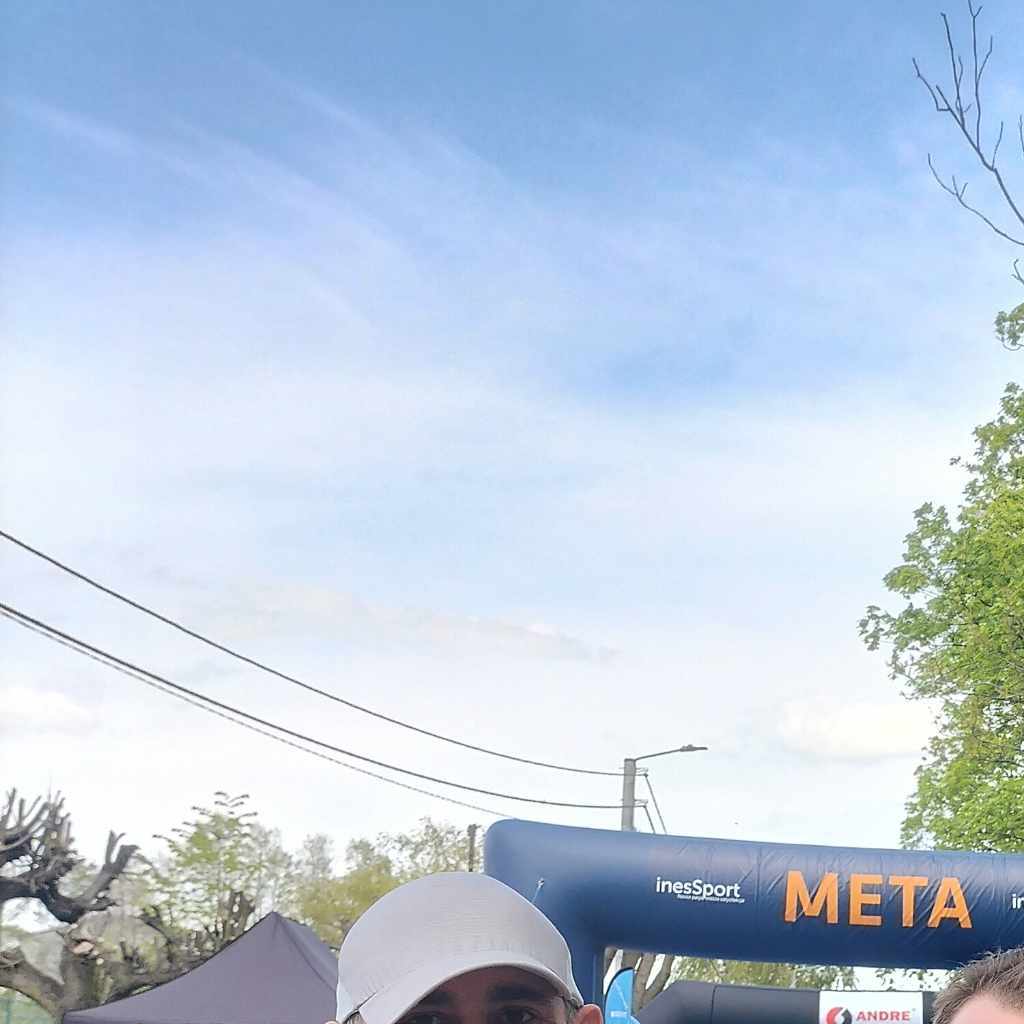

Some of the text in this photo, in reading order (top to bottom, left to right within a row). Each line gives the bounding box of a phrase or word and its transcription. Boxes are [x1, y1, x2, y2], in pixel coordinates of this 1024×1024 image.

[656, 876, 741, 898] inesSport
[784, 870, 972, 928] META
[855, 1010, 911, 1021] ANDRE
